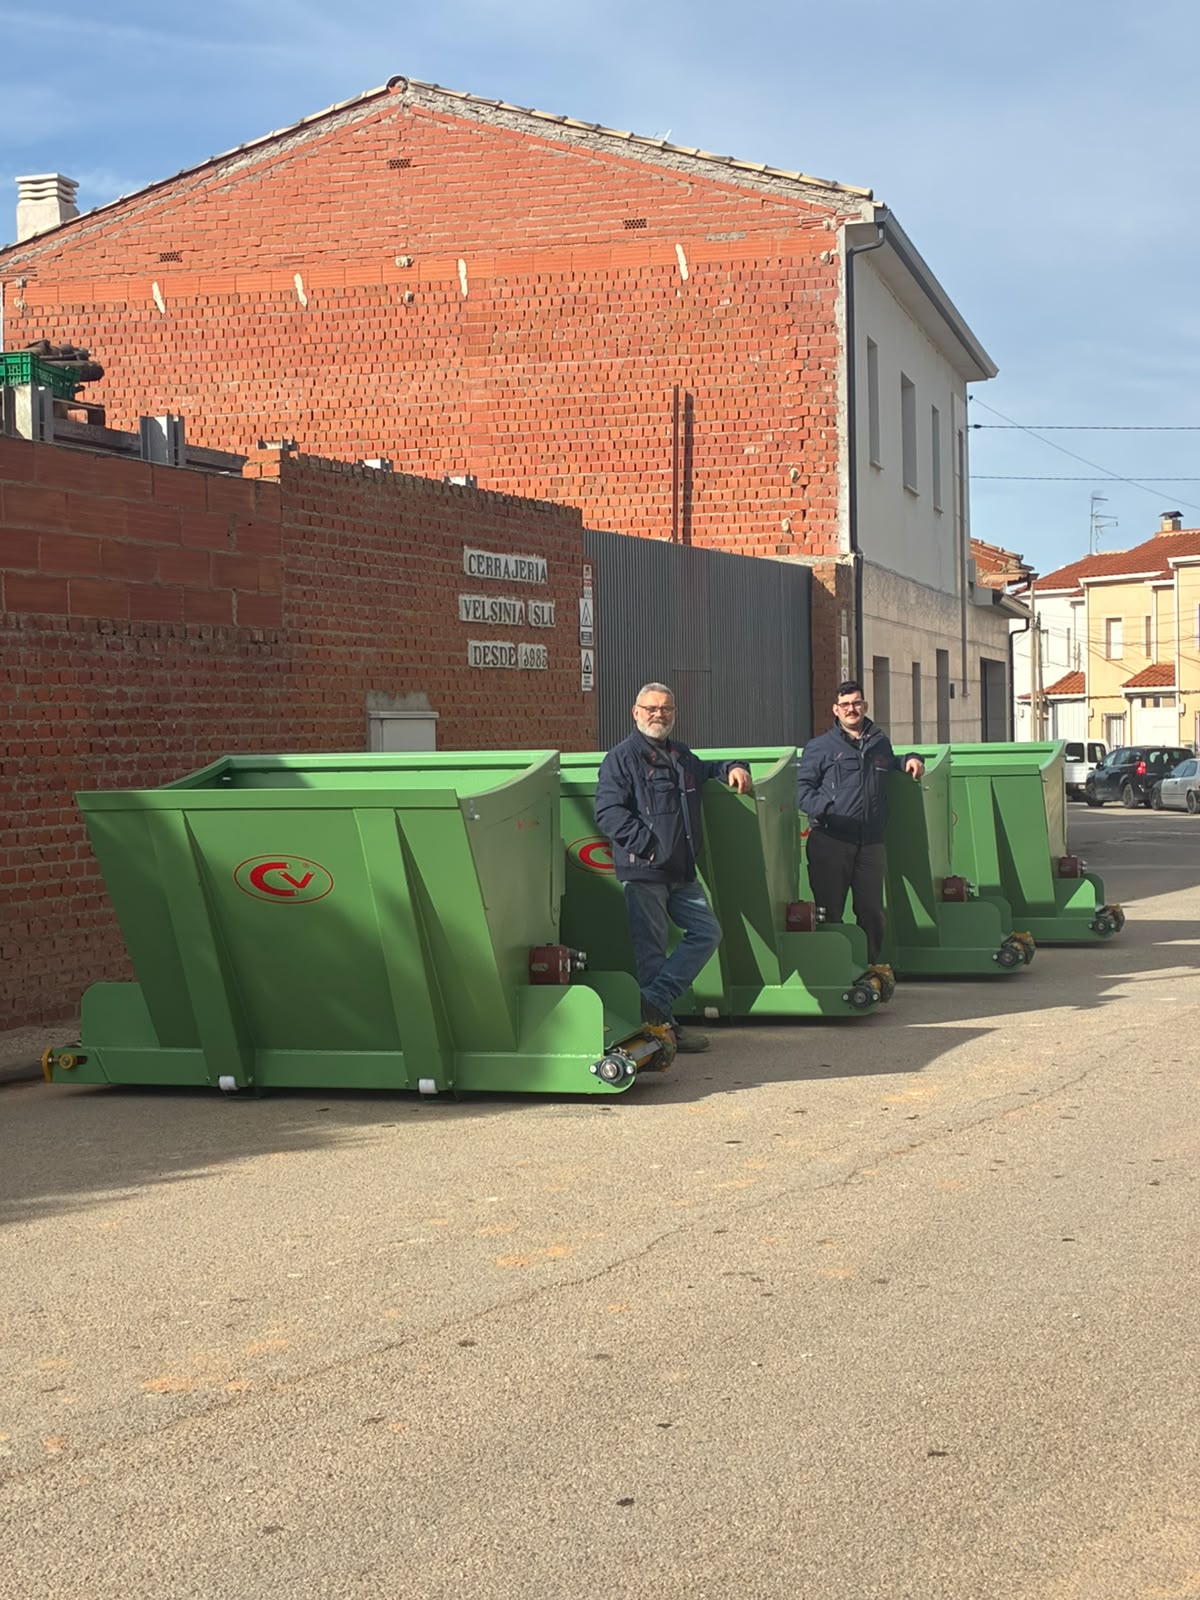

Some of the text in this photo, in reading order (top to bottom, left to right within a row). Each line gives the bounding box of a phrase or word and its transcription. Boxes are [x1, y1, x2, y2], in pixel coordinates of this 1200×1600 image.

[468, 553, 547, 582] CERRAJERIA
[464, 599, 556, 625] VELSINIA SLU
[473, 645, 516, 666] DESDE
